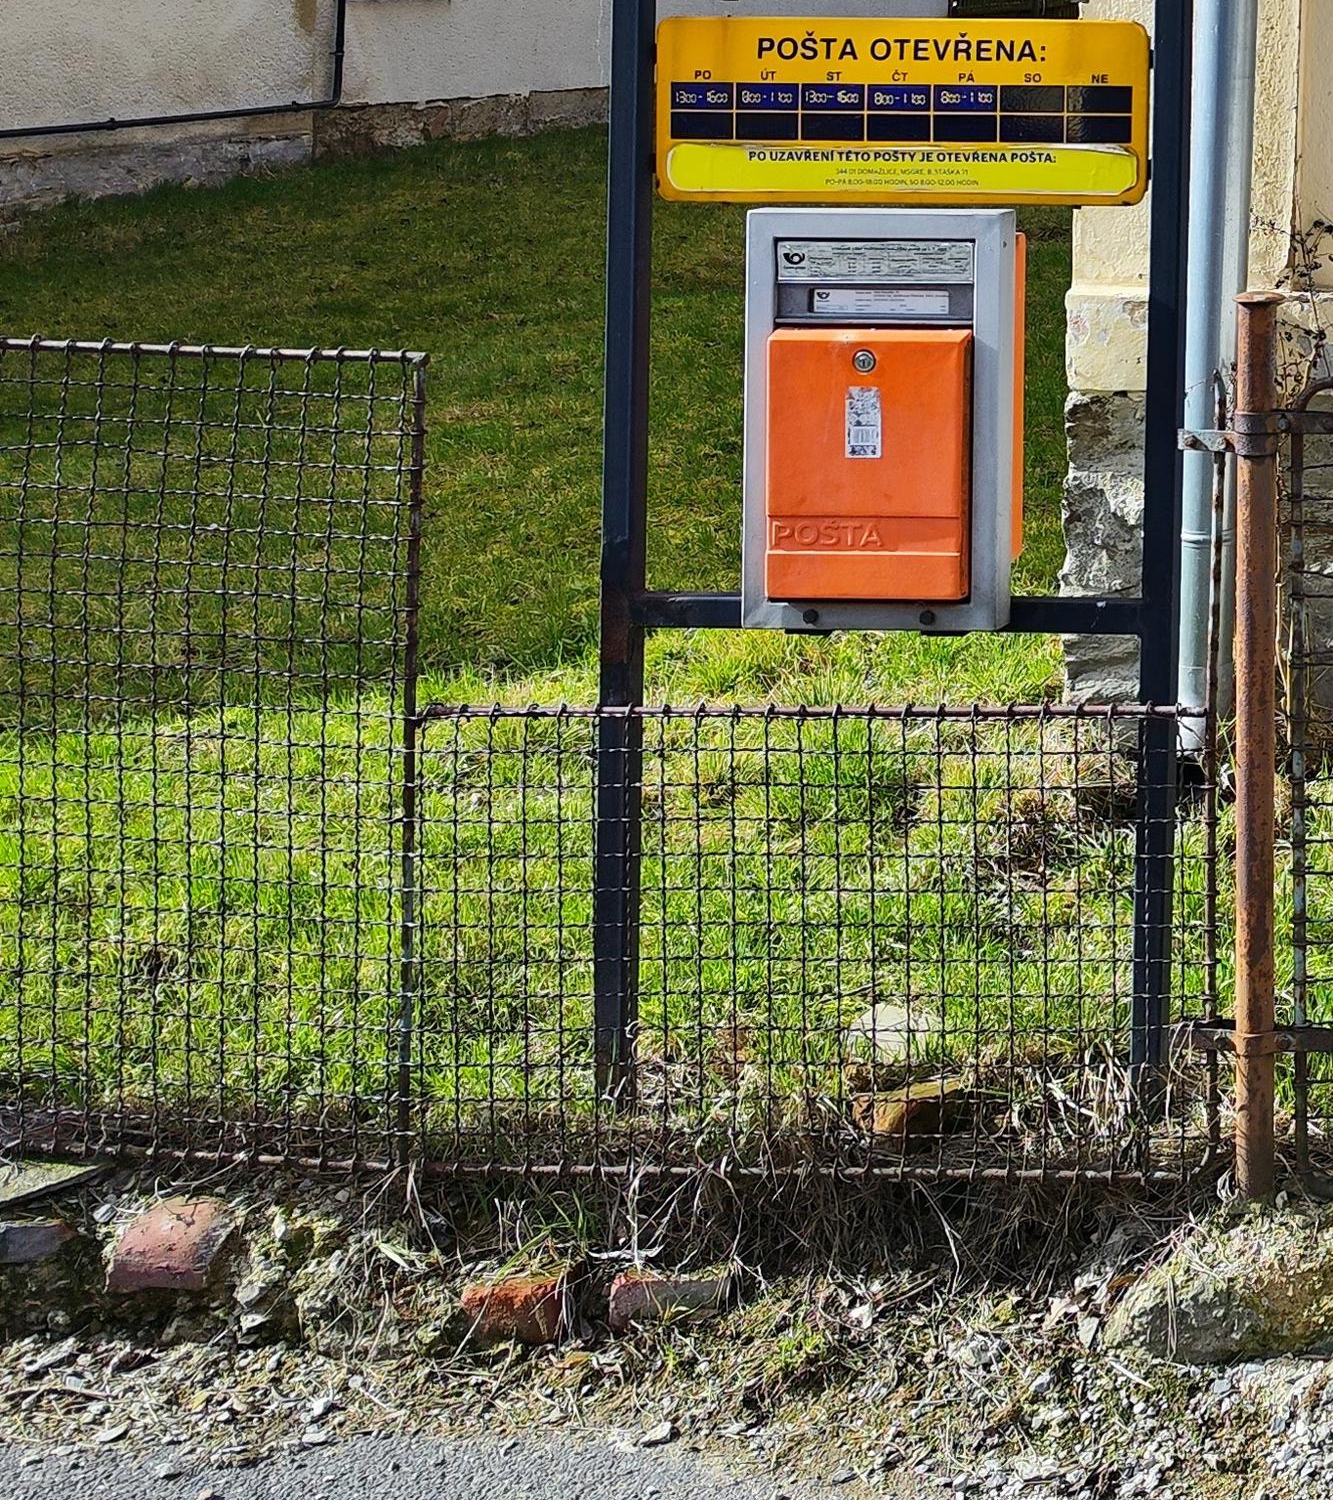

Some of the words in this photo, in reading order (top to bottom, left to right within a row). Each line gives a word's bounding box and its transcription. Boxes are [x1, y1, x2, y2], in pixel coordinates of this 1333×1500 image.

[757, 30, 858, 61] POŠTA
[870, 32, 1047, 63] OTEVŘENA:
[694, 70, 712, 80] PO
[760, 68, 777, 81] ÚT
[826, 71, 842, 81] ST
[891, 71, 908, 82] ČT
[958, 71, 975, 83] PÁ
[1024, 73, 1042, 83] SO
[1091, 74, 1109, 84] NE
[749, 151, 767, 162] PO
[769, 149, 834, 162] UZAVŘENÍ
[837, 150, 870, 162] TÉTO
[873, 150, 917, 162] POŠTY
[919, 151, 933, 163] JE
[936, 151, 1008, 163] OTEVŘENA
[1011, 151, 1057, 163] POŠTA:
[771, 519, 883, 547] POŠTA
